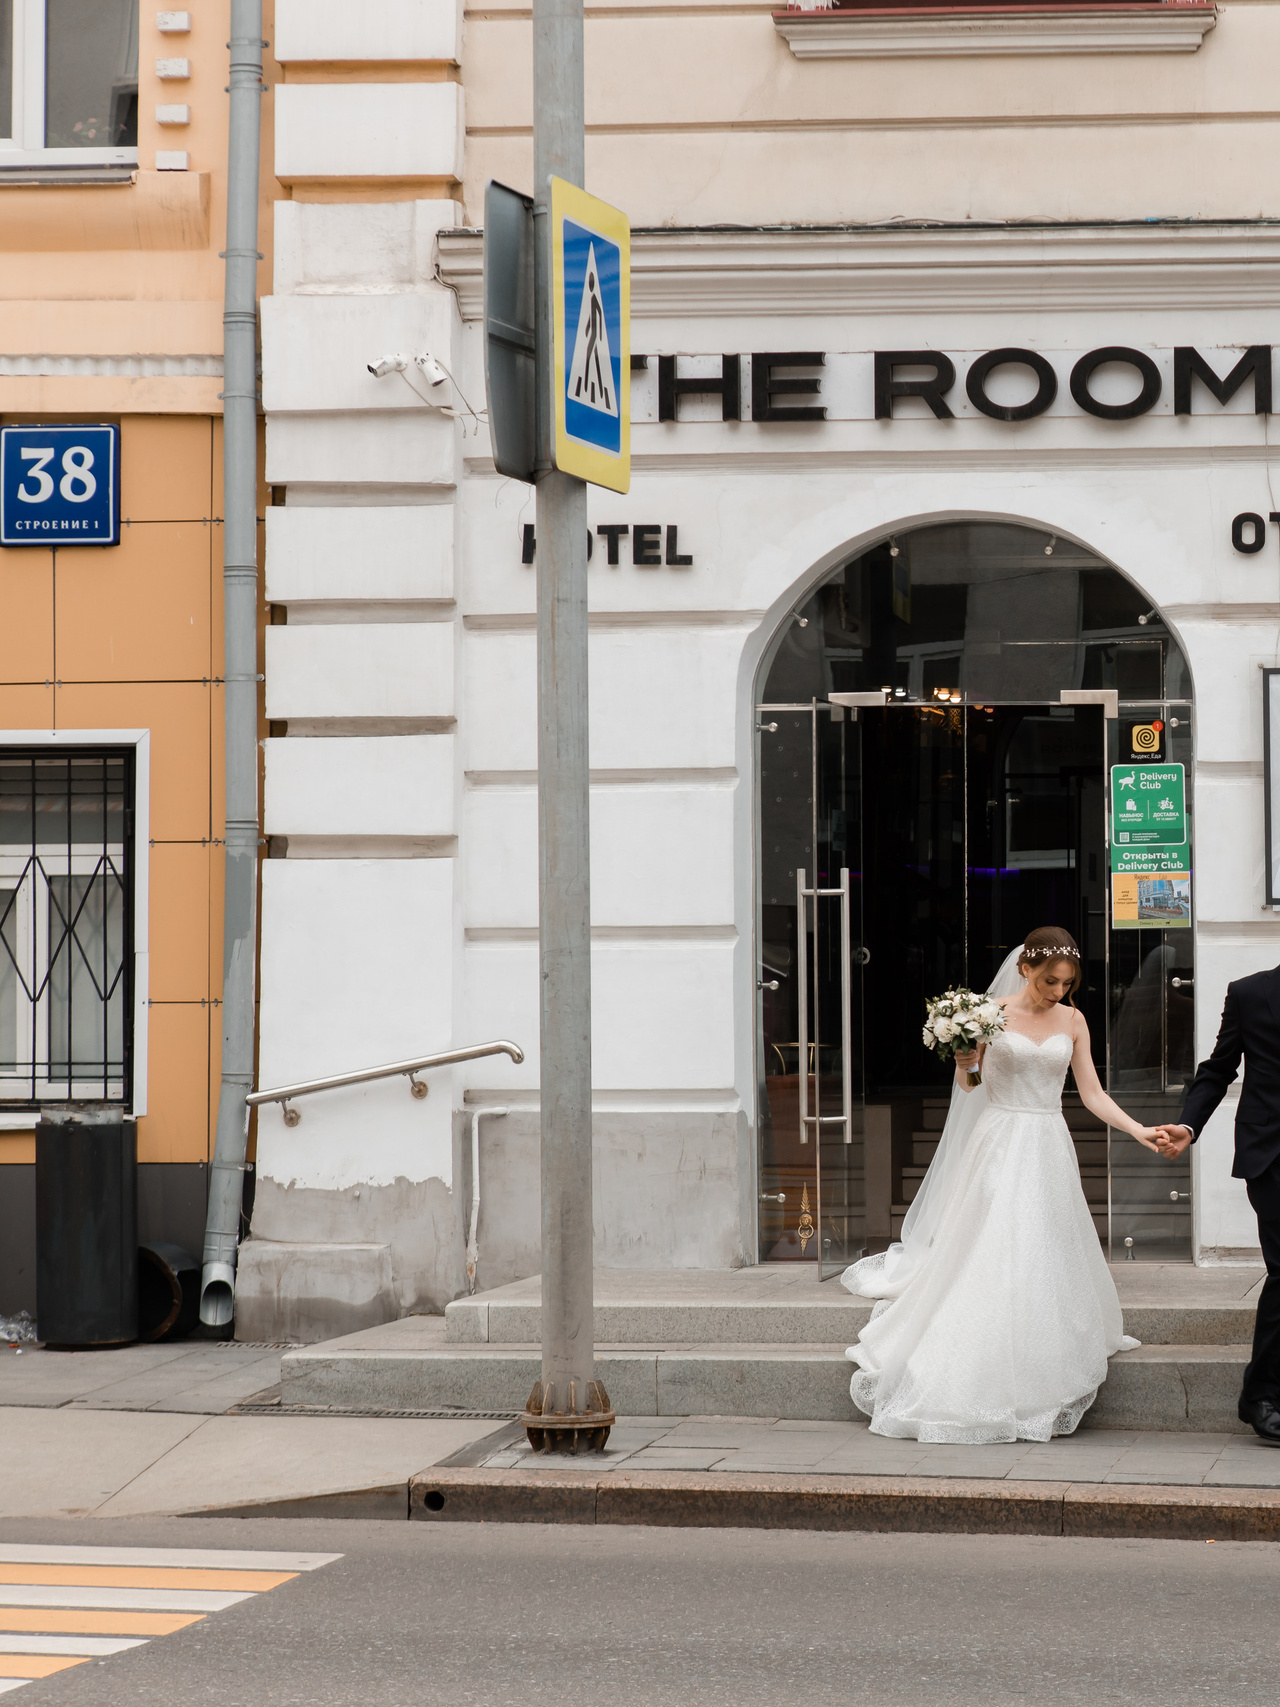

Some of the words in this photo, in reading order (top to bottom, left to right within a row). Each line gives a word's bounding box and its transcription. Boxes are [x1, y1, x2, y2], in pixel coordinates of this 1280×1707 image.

[630, 351, 827, 422] HE
[17, 446, 97, 504] 38
[15, 520, 89, 530] СТРОЕНИЕ
[94, 520, 99, 529] 1
[522, 523, 693, 566] TEL
[1140, 773, 1177, 782] Delivery
[1140, 781, 1161, 789] Club
[1122, 852, 1169, 861] Открыты
[1118, 862, 1158, 871] Delivery
[1161, 861, 1183, 869] Club
